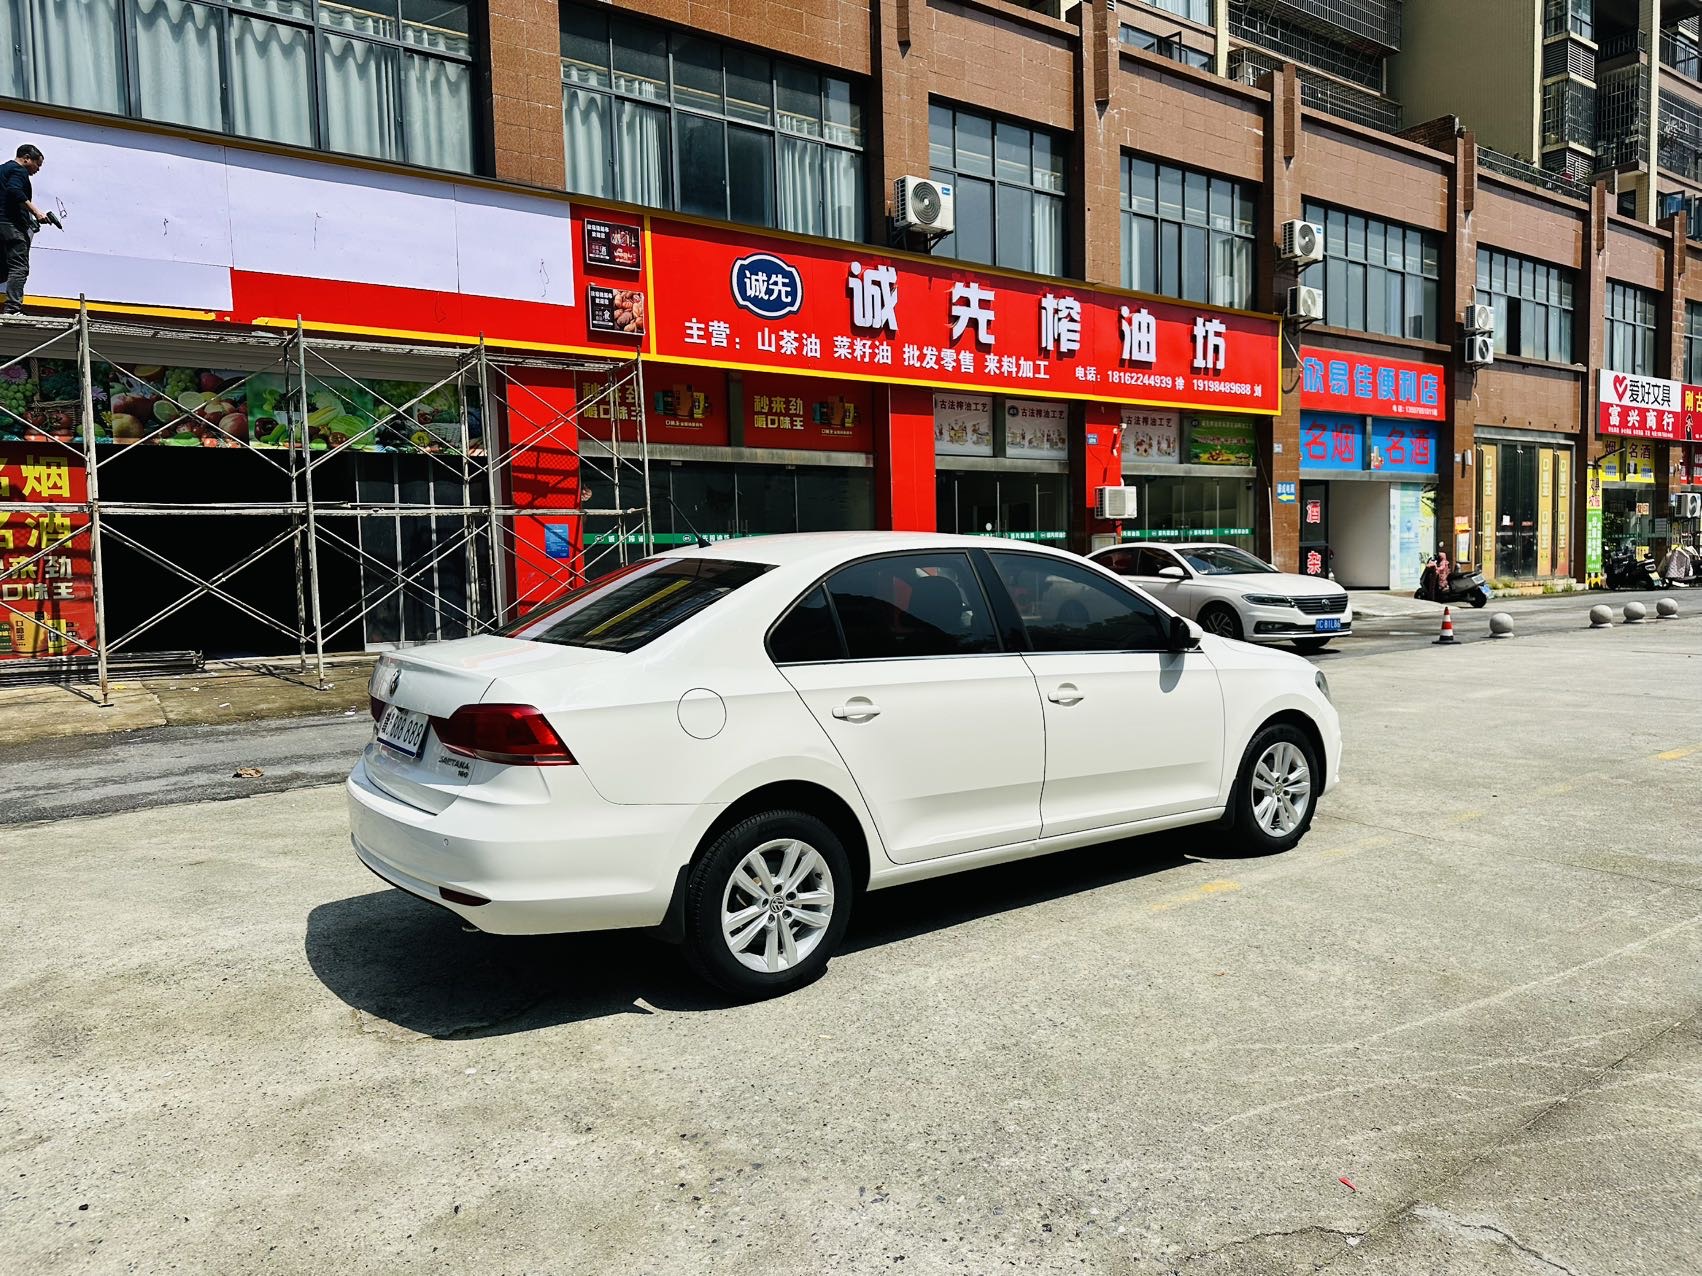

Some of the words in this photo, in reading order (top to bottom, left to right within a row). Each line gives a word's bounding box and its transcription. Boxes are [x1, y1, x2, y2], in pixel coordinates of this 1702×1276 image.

[744, 269, 791, 303] 诚先
[848, 261, 1227, 370] 诚先榨油坊
[684, 317, 741, 350] 主营：
[757, 327, 821, 358] 山茶油
[833, 335, 892, 365] 菜籽油
[903, 343, 975, 374] 批发零售
[984, 353, 1050, 379] 来料加工
[1075, 365, 1101, 382] 电话：
[1107, 370, 1172, 389] 18162244939
[1192, 379, 1251, 395] 19198489688
[1253, 384, 1262, 398] 刘
[1303, 357, 1439, 405] 欣易佳便利店
[1629, 380, 1671, 407] 爱好文具
[753, 395, 804, 415] 秒来劲
[939, 399, 988, 412] 古法榨油工艺
[1021, 408, 1065, 420] 古法榨油工艺
[1608, 404, 1674, 432] 富兴商行
[1126, 415, 1173, 428] 古法榨油工艺
[1304, 420, 1354, 463] 名烟
[1386, 429, 1430, 465] 名酒
[1629, 442, 1651, 460] 名酒
[0, 454, 70, 497] 烟
[1306, 500, 1321, 523] 酒
[0, 556, 73, 580] 来劲
[2, 582, 75, 600] 口味王
[403, 719, 424, 747] 888
